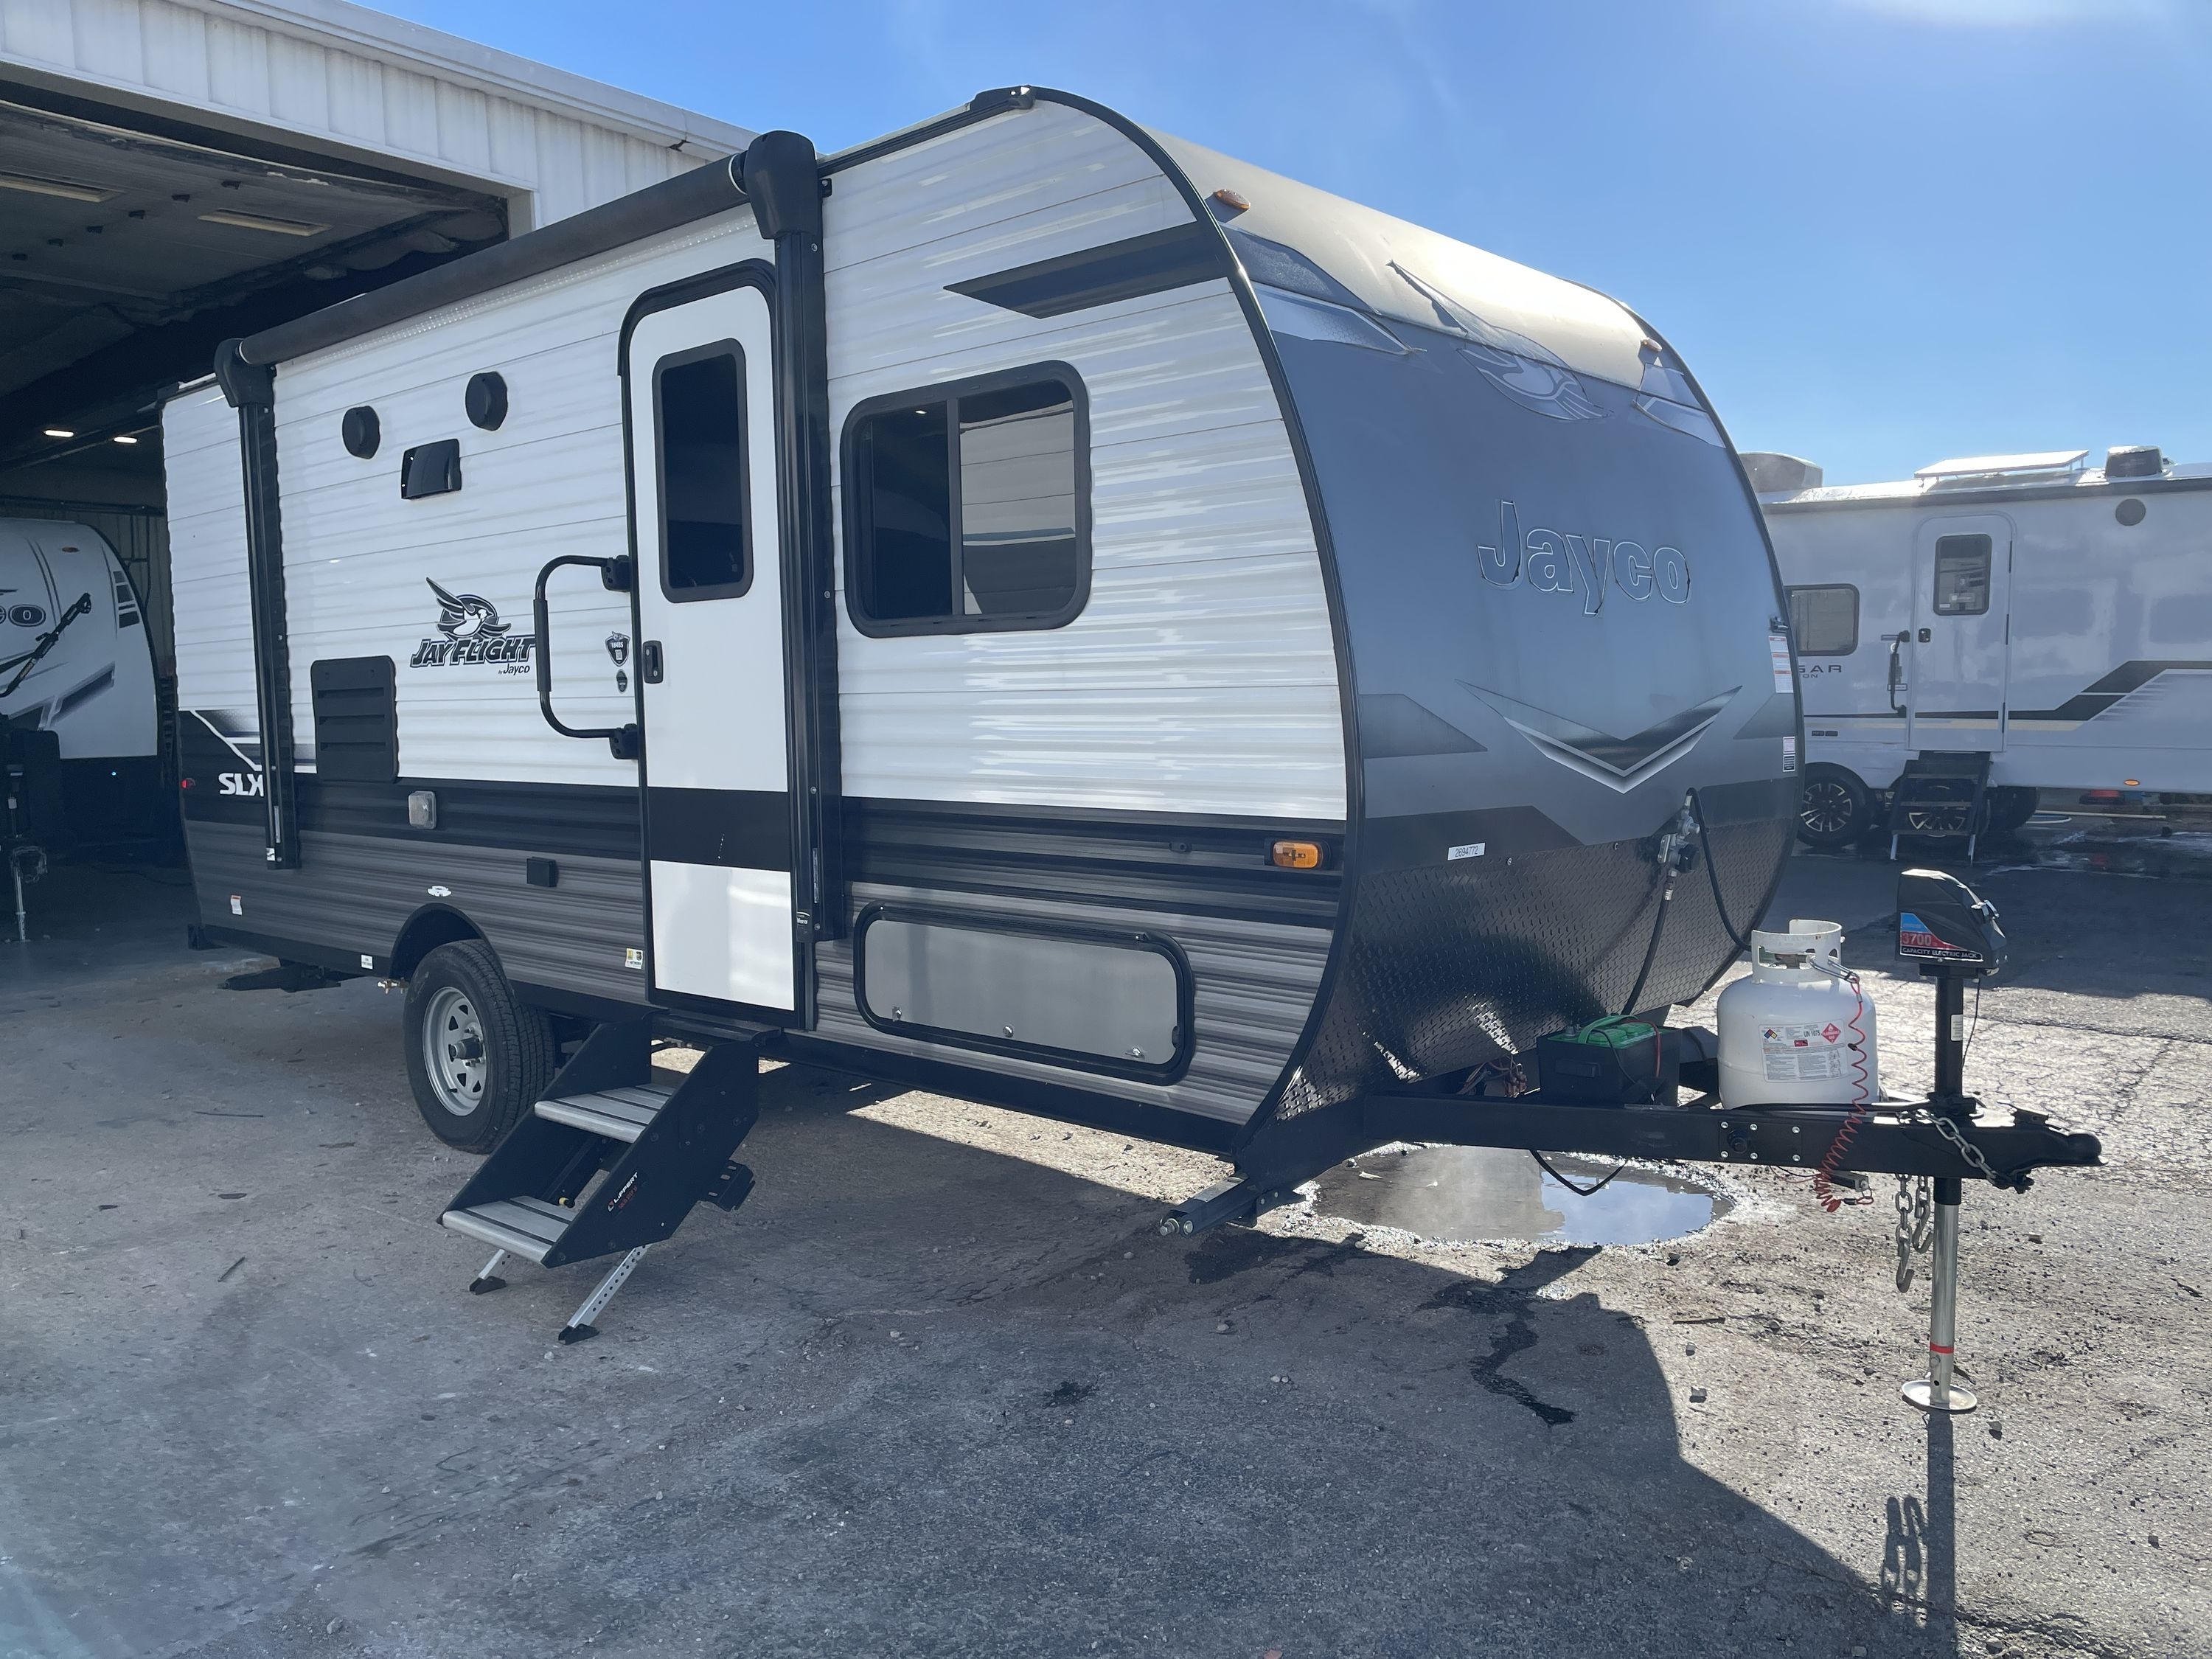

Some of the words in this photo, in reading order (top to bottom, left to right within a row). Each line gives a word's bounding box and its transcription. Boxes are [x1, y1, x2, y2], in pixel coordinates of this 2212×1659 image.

[1477, 500, 1690, 617] Jayco
[410, 639, 453, 667] JAY
[449, 635, 536, 665] FLIGHT
[503, 664, 530, 675] Jayco
[218, 773, 264, 797] SLX
[1902, 932, 1932, 946] 3700
[1902, 947, 1930, 955] CAPACITY
[1932, 950, 1960, 958] ELECTRIC
